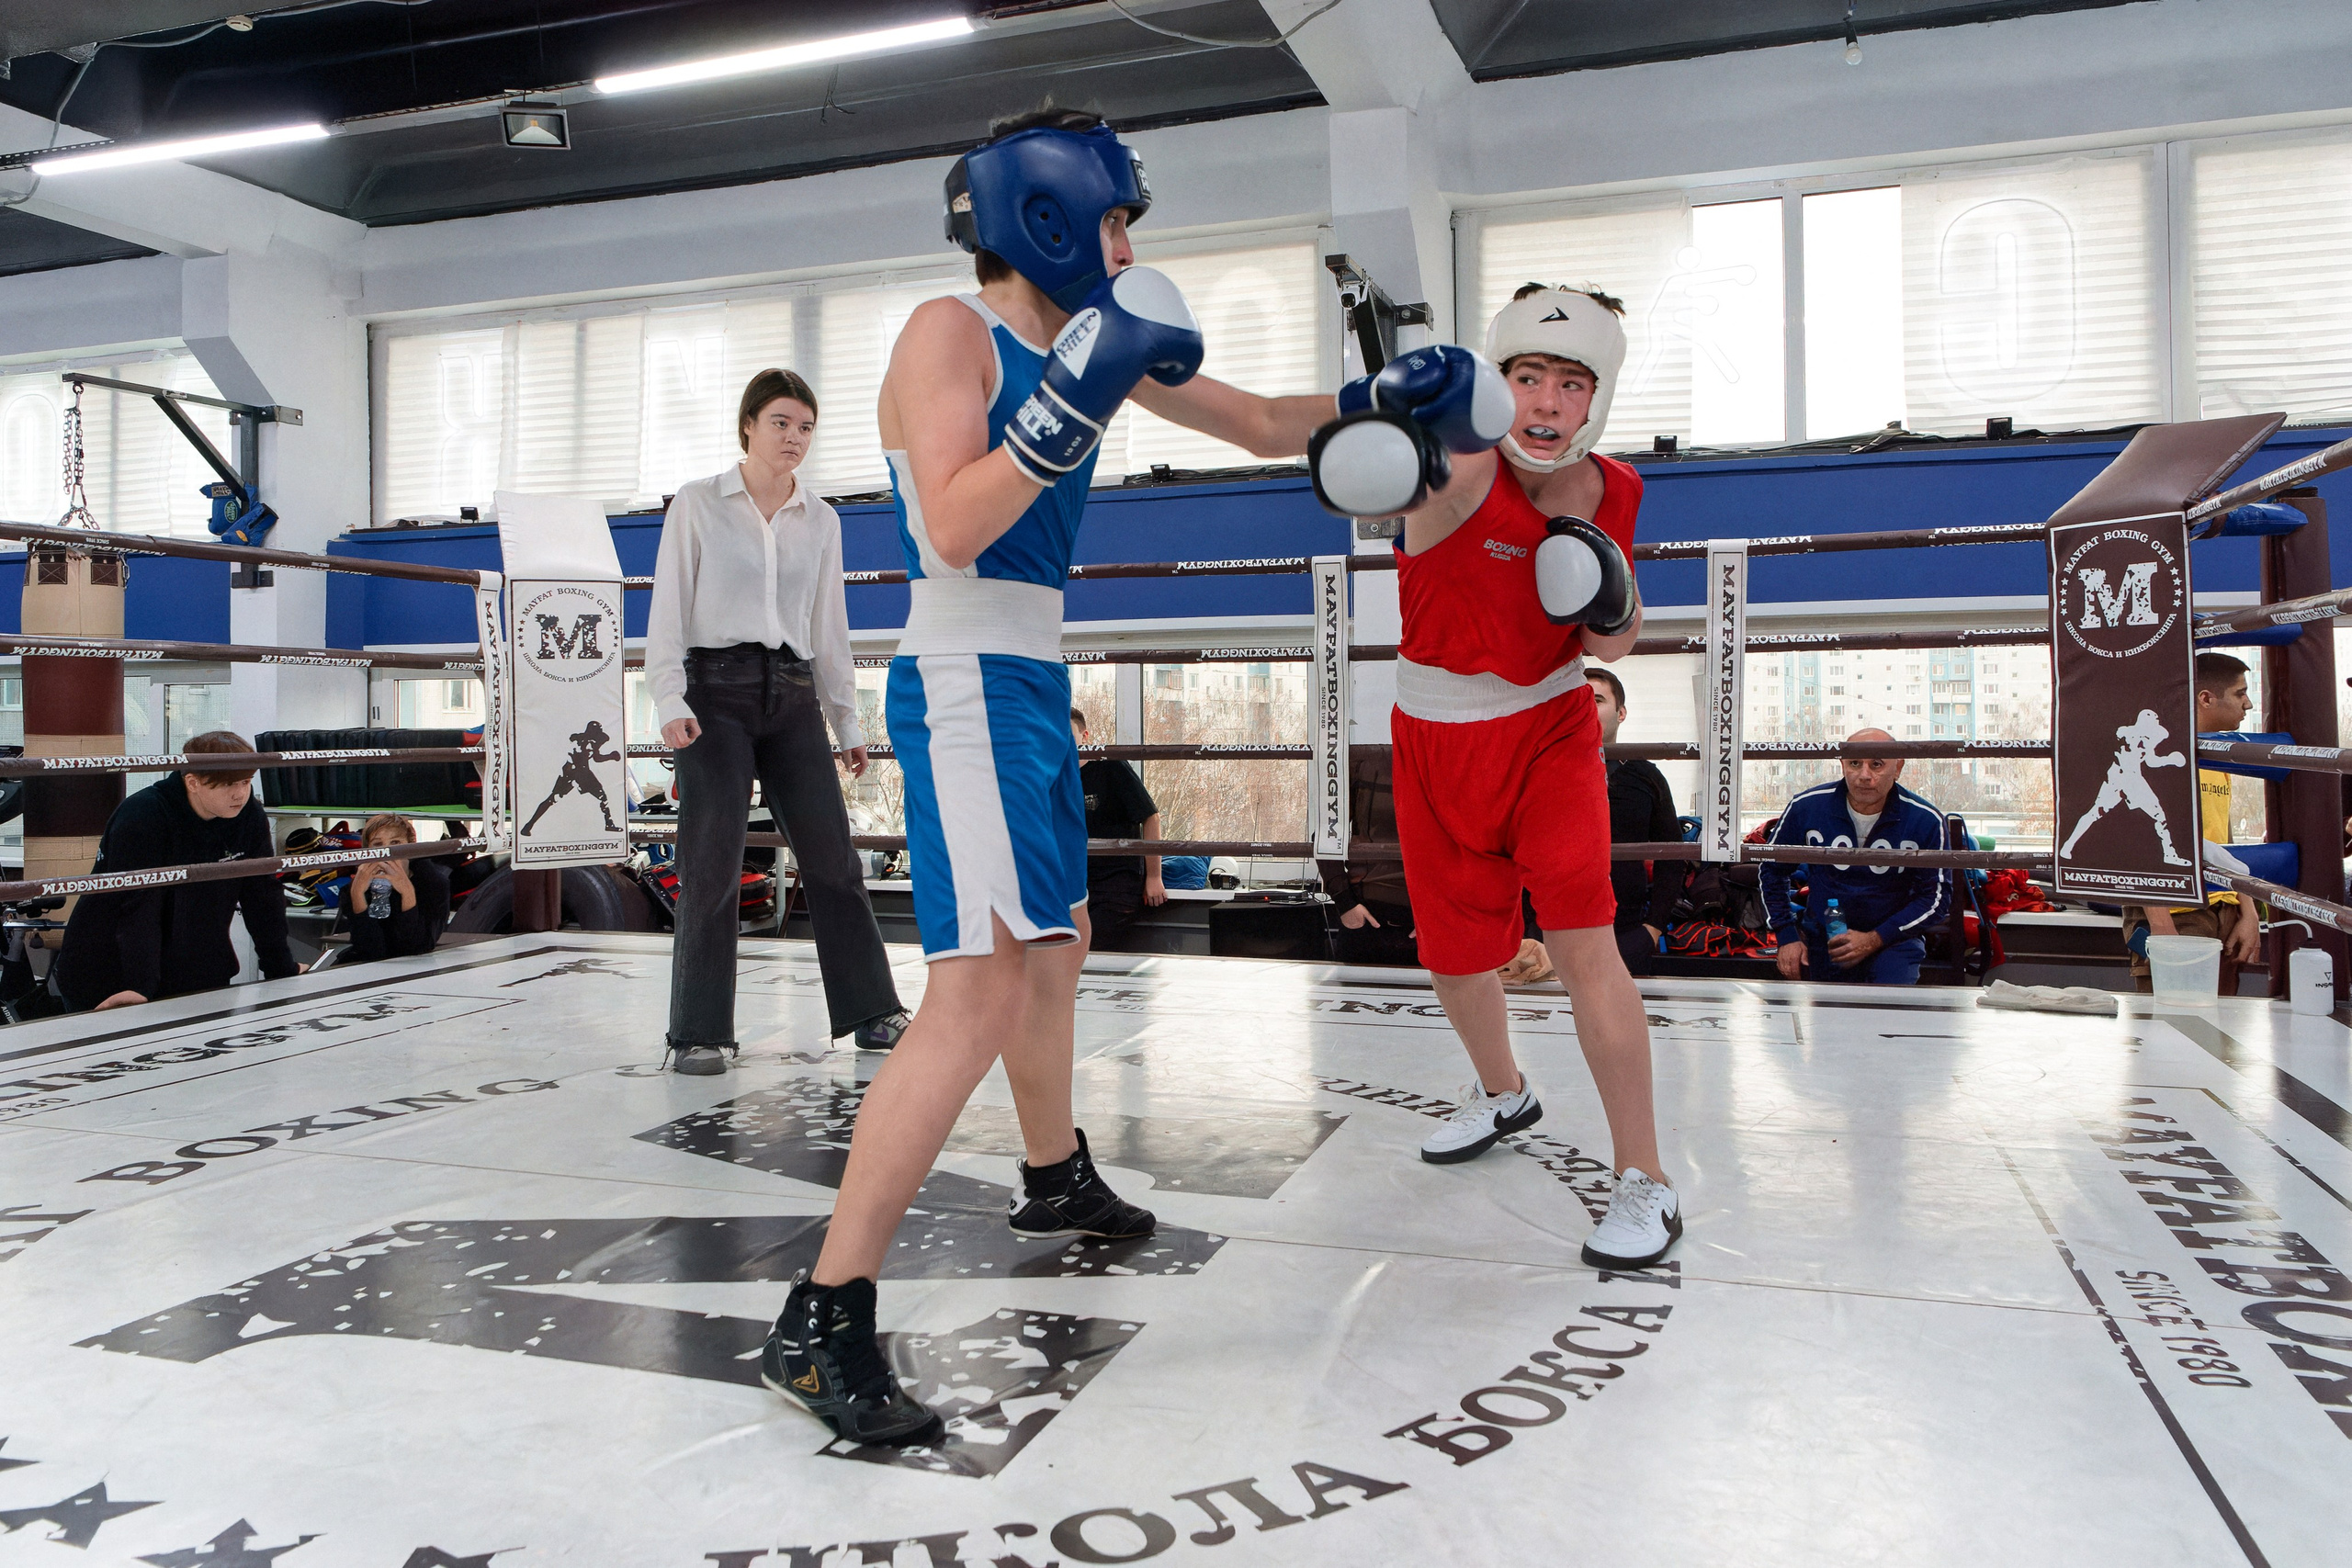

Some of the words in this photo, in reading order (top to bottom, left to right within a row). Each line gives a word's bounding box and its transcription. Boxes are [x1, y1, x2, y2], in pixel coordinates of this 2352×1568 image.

[1177, 557, 1306, 570] MAYFATBOXINGGYM
[2064, 536, 2099, 574] MAYFAT
[2103, 529, 2149, 543] BOXING
[2151, 540, 2175, 564] GYM
[522, 591, 553, 616] MAYFAT
[557, 587, 594, 601] BOXING
[596, 599, 615, 617] GYM
[484, 600, 502, 840] MAYFATBOXINGGYM
[1325, 574, 1340, 840] MAYFATBOXINGGYM
[1717, 564, 1736, 851] MAYFATBOXINGGYM
[43, 754, 189, 771] MAYFATBOXINGGYM
[525, 842, 618, 853] MAYFATBOXINGGYM
[42, 869, 187, 896] MAYFATBOXINGGYM
[2064, 872, 2186, 889] MAYFATBOXINGGYM
[74, 1077, 559, 1186] BOXING
[2115, 1269, 2210, 1332] SINCE
[1385, 1303, 1674, 1467] БОКСА
[2160, 1336, 2253, 1388] 1980
